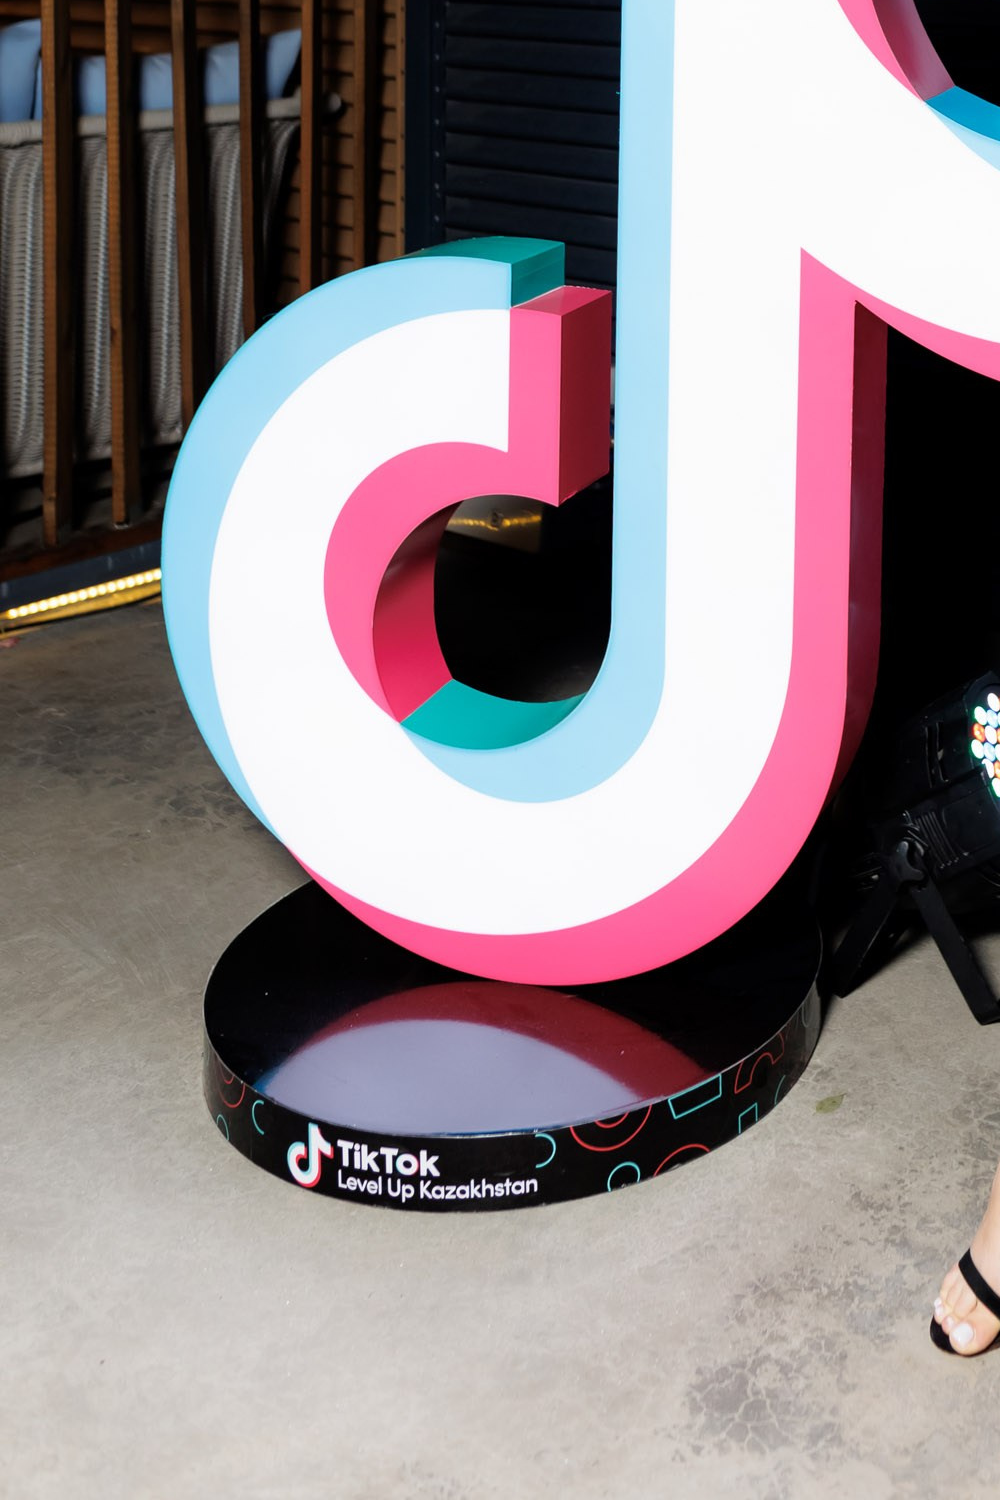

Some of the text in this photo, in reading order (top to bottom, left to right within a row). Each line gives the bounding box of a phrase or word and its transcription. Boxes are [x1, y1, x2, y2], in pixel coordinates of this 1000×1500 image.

[337, 1139, 440, 1177] TikTok
[338, 1169, 538, 1203] Level Up Kazakhstan
